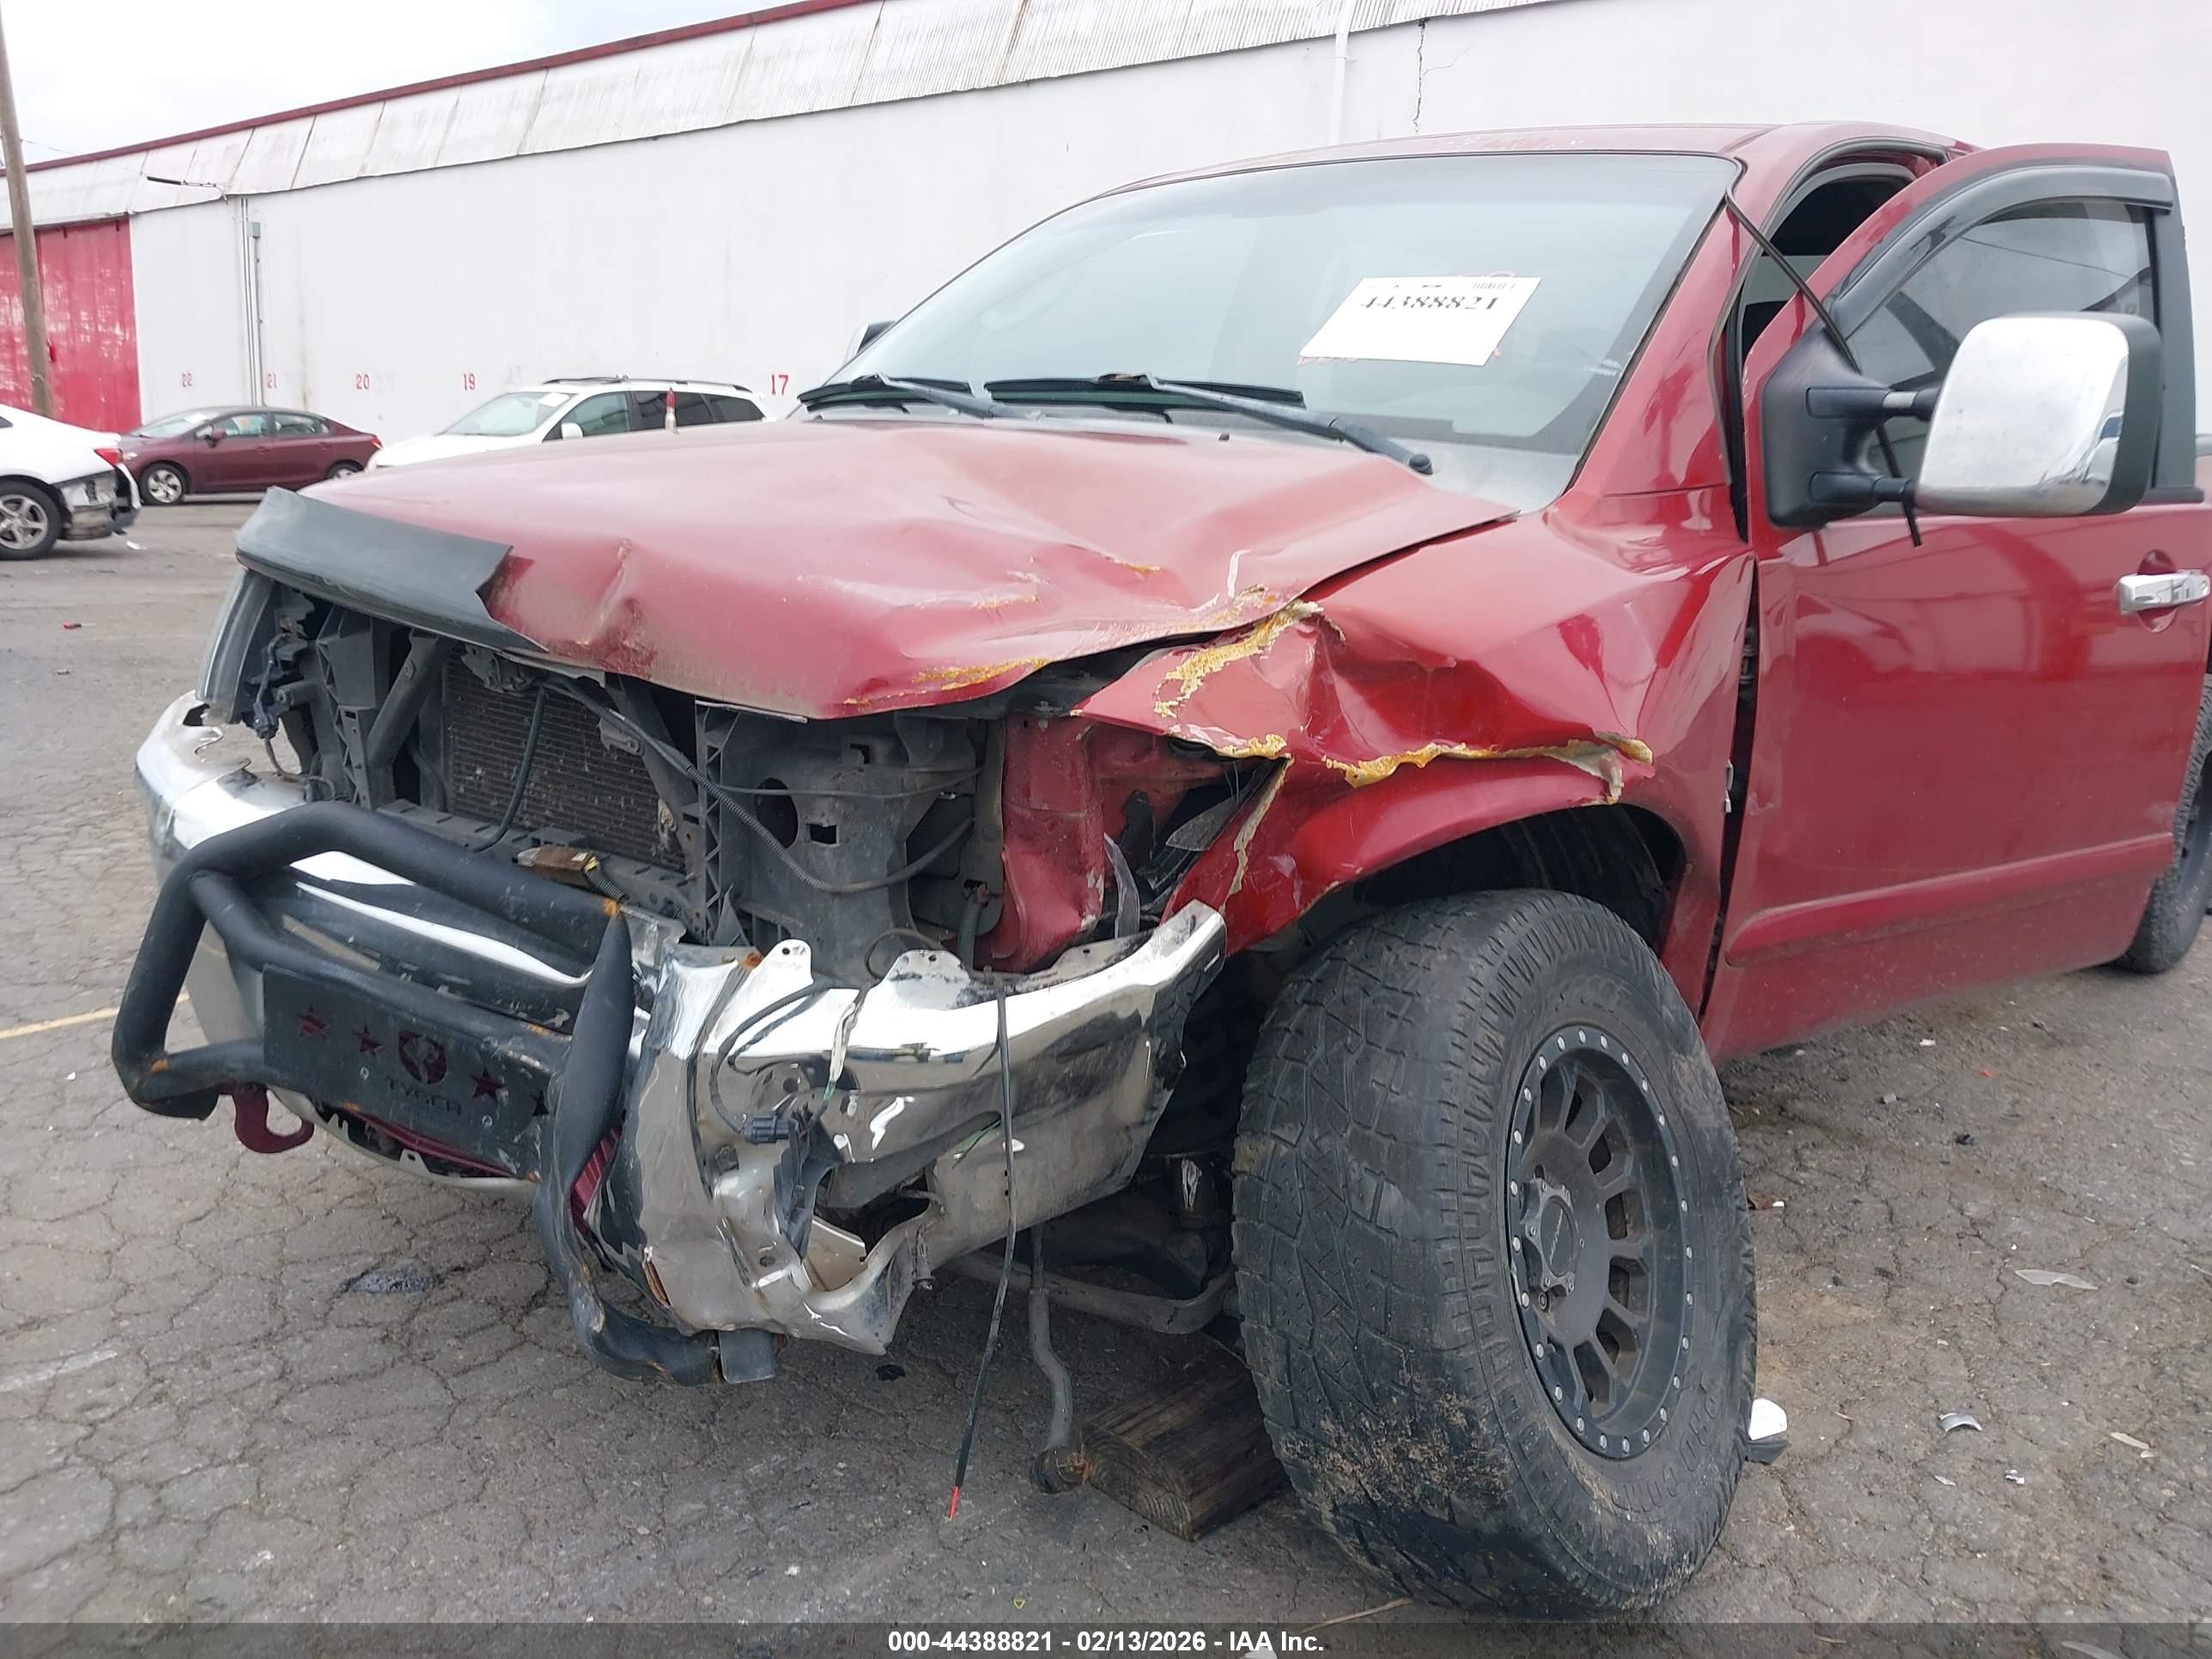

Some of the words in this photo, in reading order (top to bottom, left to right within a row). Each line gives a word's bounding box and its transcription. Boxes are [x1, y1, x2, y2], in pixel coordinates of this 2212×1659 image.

[356, 374, 370, 390] 20
[463, 373, 476, 391] 19
[771, 374, 789, 395] 17
